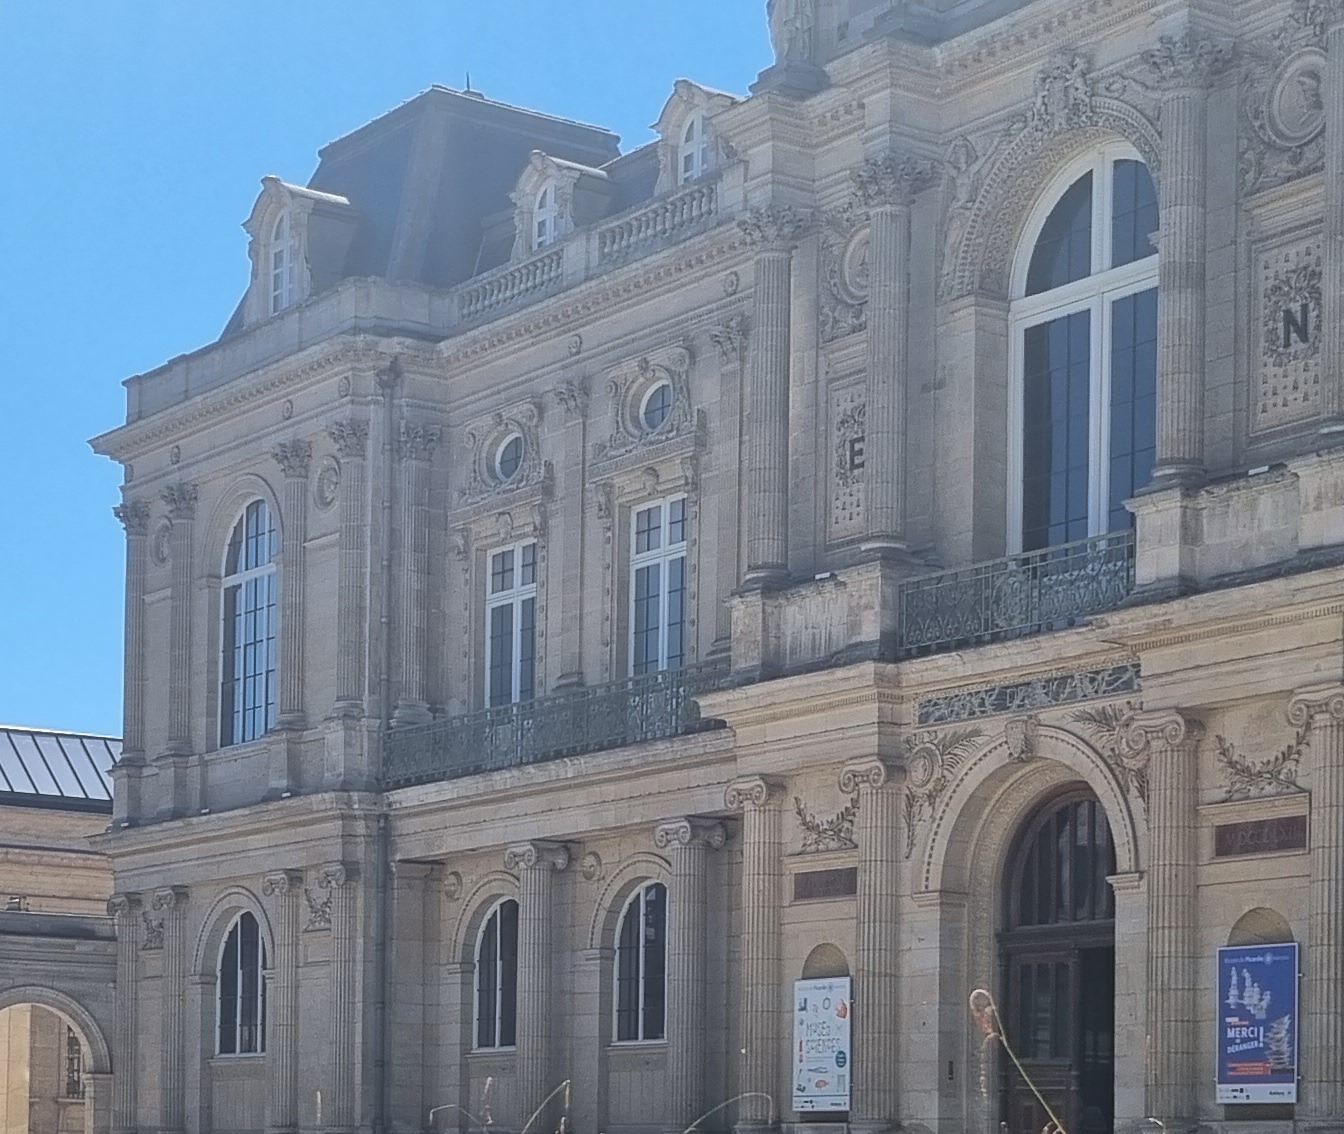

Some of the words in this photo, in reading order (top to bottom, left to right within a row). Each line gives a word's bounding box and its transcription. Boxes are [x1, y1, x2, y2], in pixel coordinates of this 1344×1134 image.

[1282, 303, 1309, 349] N
[848, 435, 865, 471] E
[1227, 1027, 1258, 1038] MERCI
